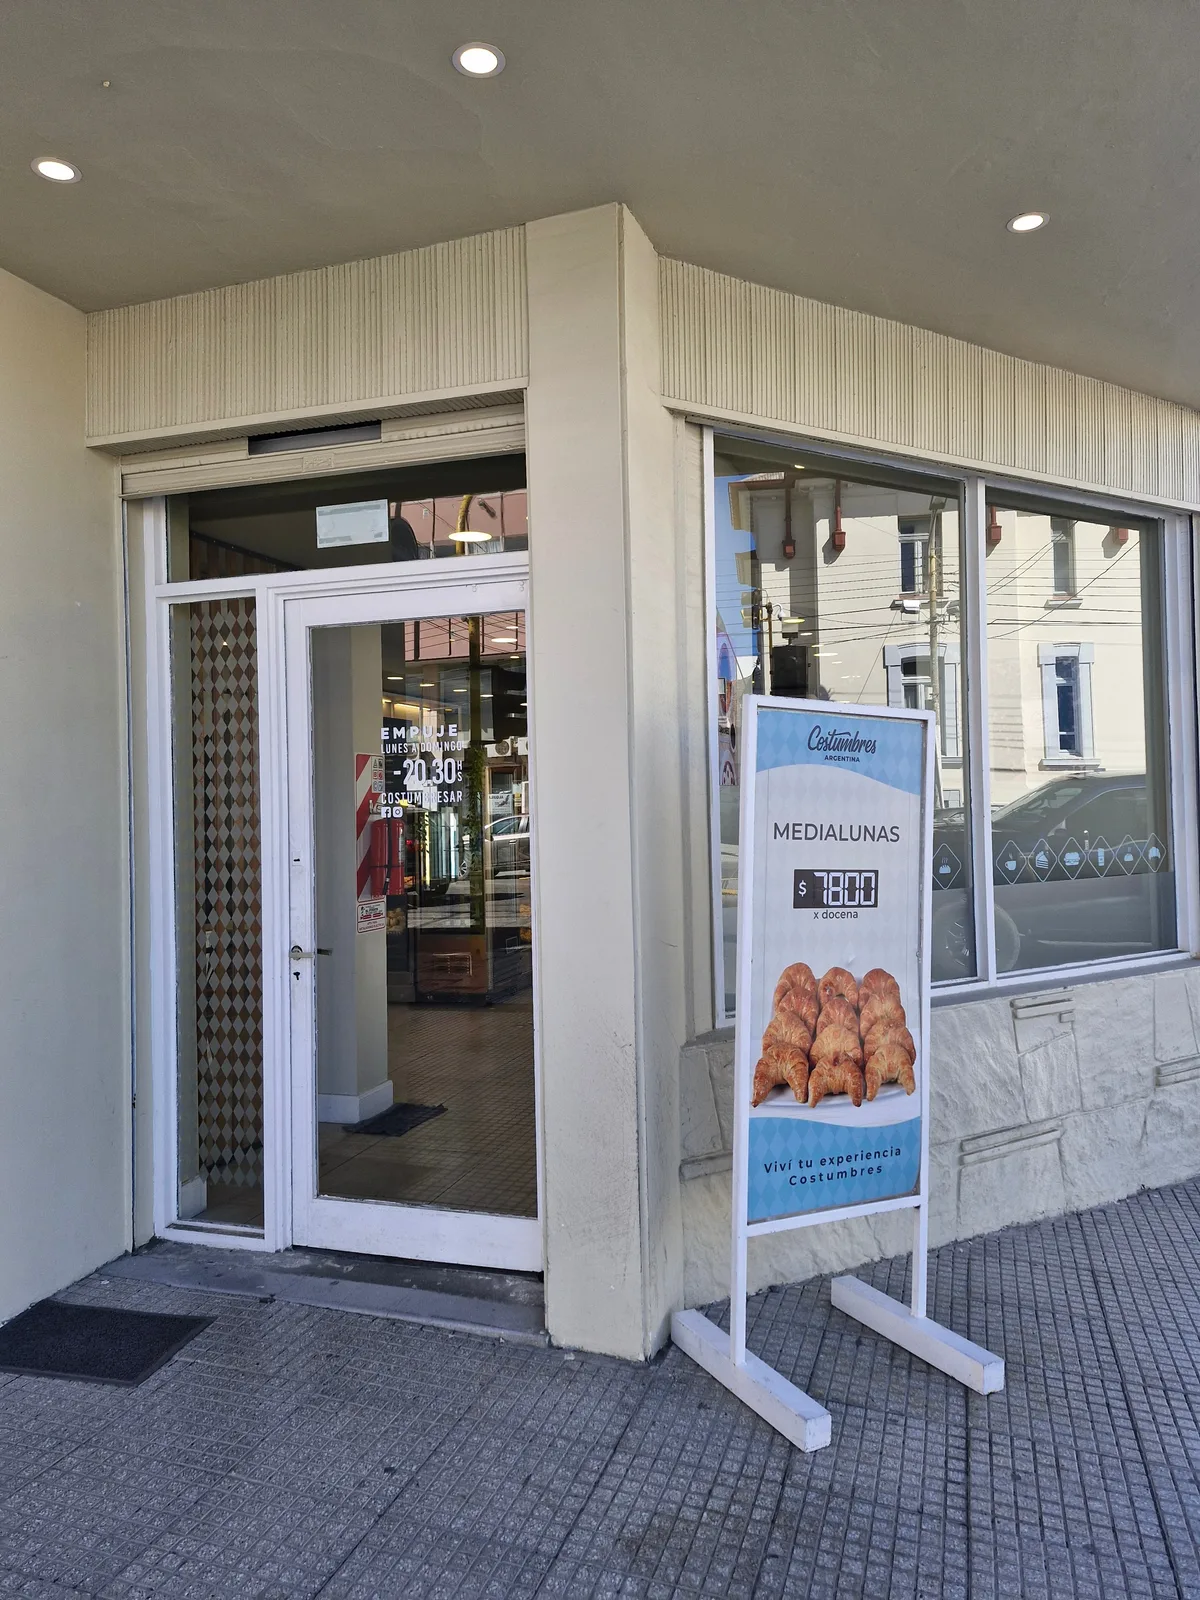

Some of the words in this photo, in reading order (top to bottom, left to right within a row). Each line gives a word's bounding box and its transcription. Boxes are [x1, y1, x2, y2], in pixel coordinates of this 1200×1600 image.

[381, 724, 458, 739] EMPUJE
[807, 725, 877, 754] Costumbres
[381, 743, 408, 754] LUNES
[411, 743, 417, 753] A
[420, 741, 462, 752] DOMINGO
[824, 755, 860, 763] ARGENTINA
[381, 791, 462, 804] COSTUMBRESAR
[773, 823, 900, 842] MEDIALUNAS
[798, 880, 807, 897] $
[821, 909, 859, 919] docena
[764, 1159, 792, 1173] Viví
[798, 1158, 813, 1169] tu
[820, 1146, 901, 1167] experiencia
[789, 1165, 882, 1186] Costumbres
